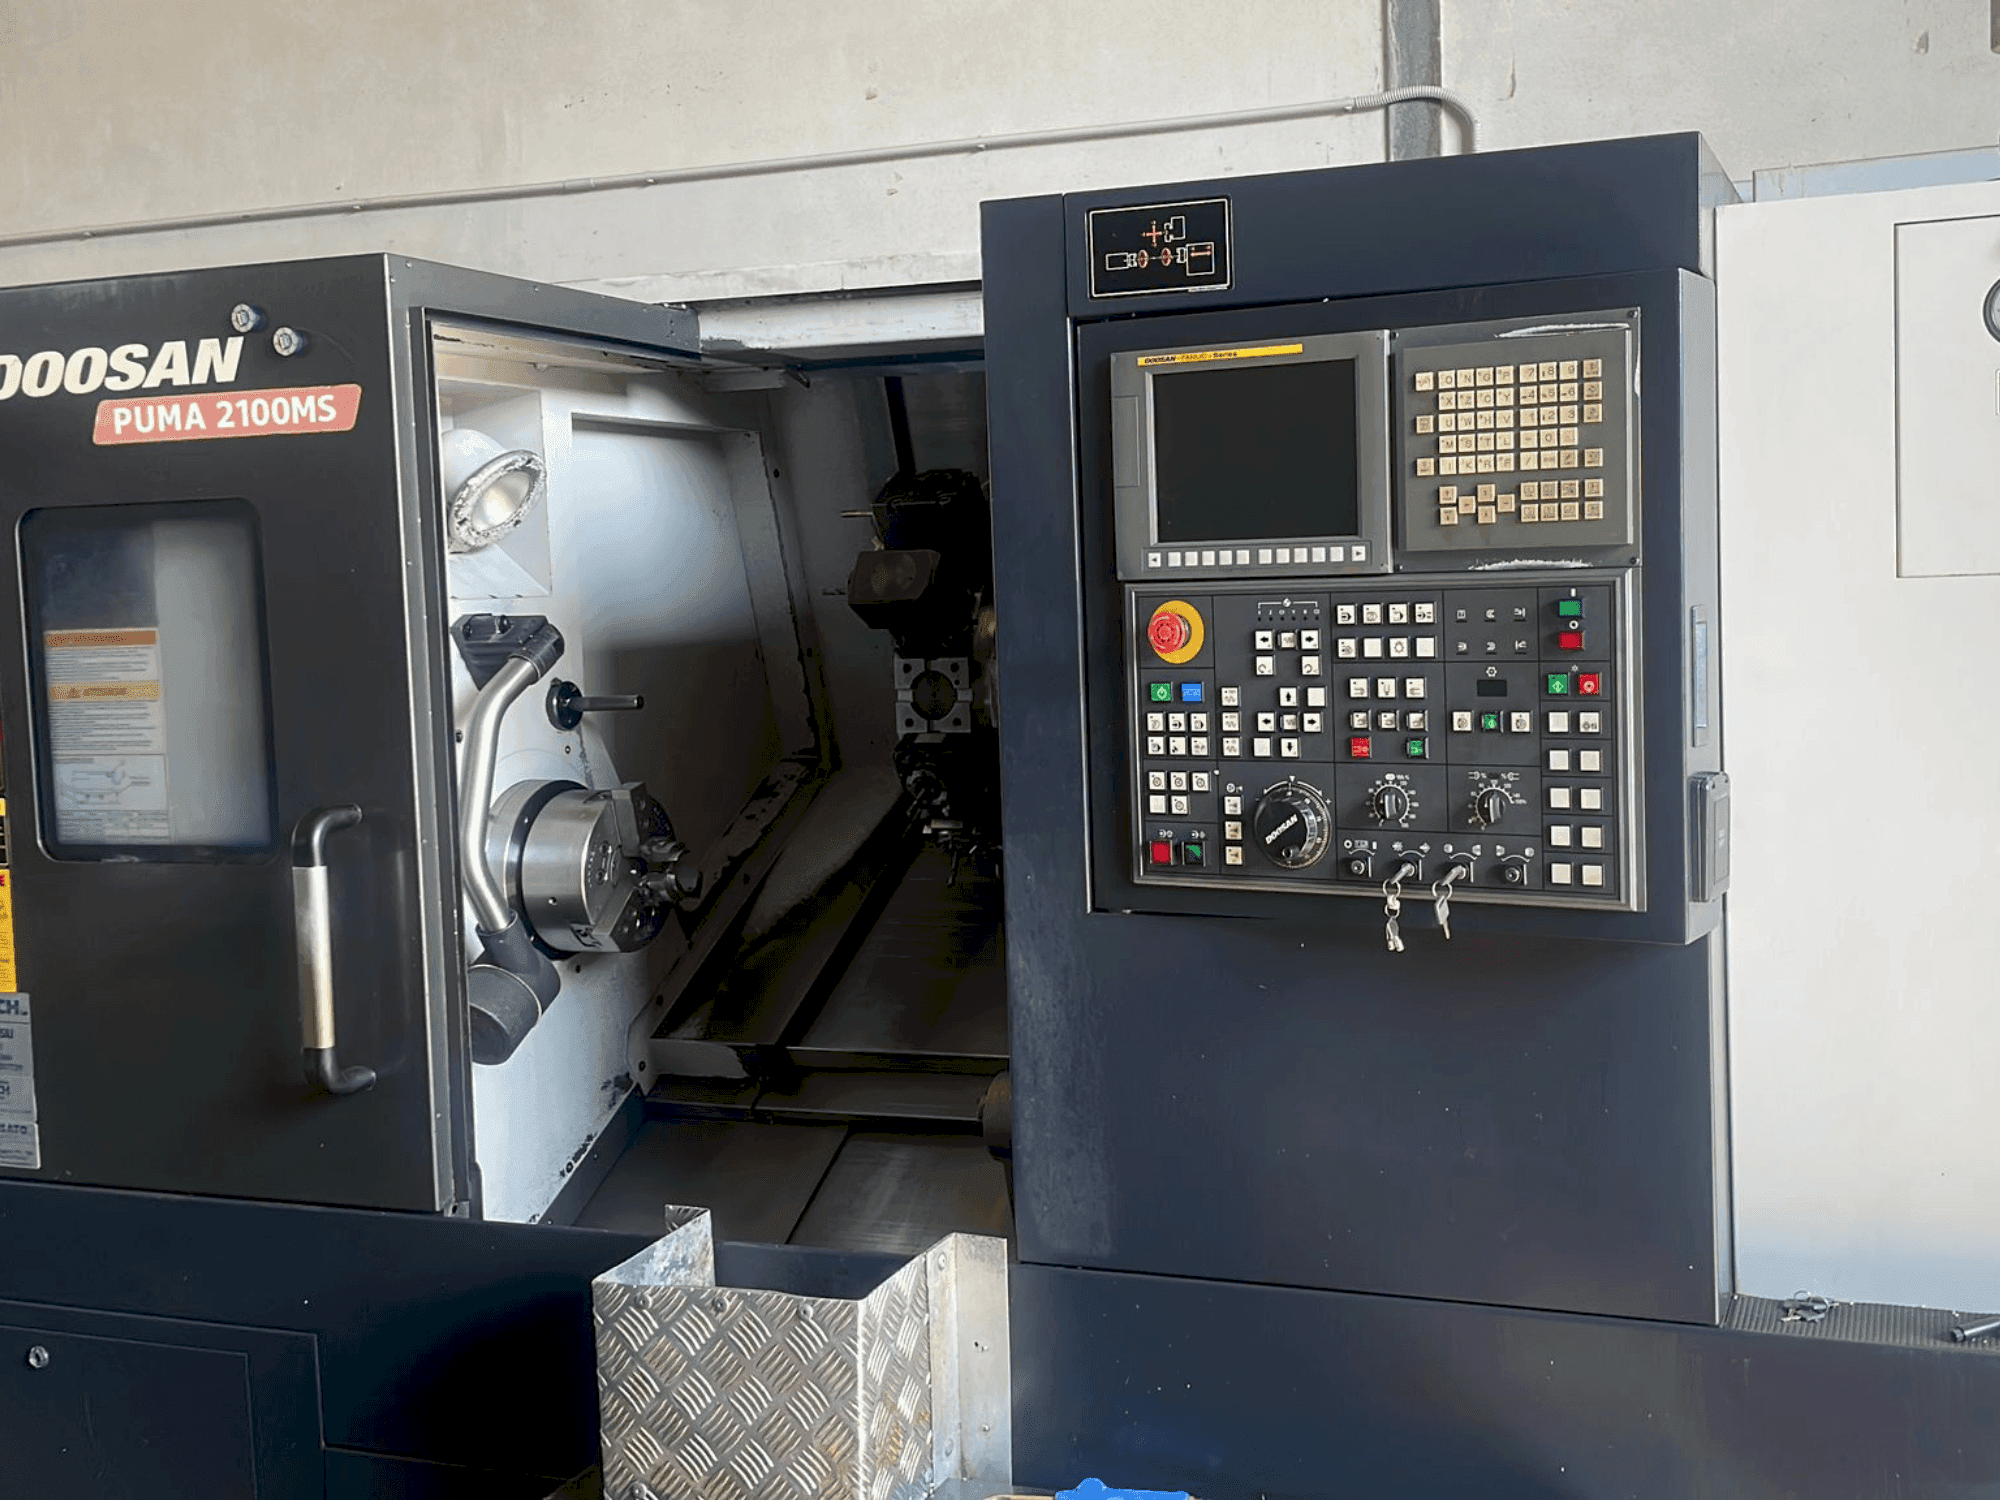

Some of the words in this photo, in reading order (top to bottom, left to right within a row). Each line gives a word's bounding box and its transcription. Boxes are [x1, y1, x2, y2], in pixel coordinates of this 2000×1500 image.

[113, 402, 207, 435] PUMA
[216, 394, 337, 428] 2100MS
[1265, 813, 1298, 845] DOOSAN
